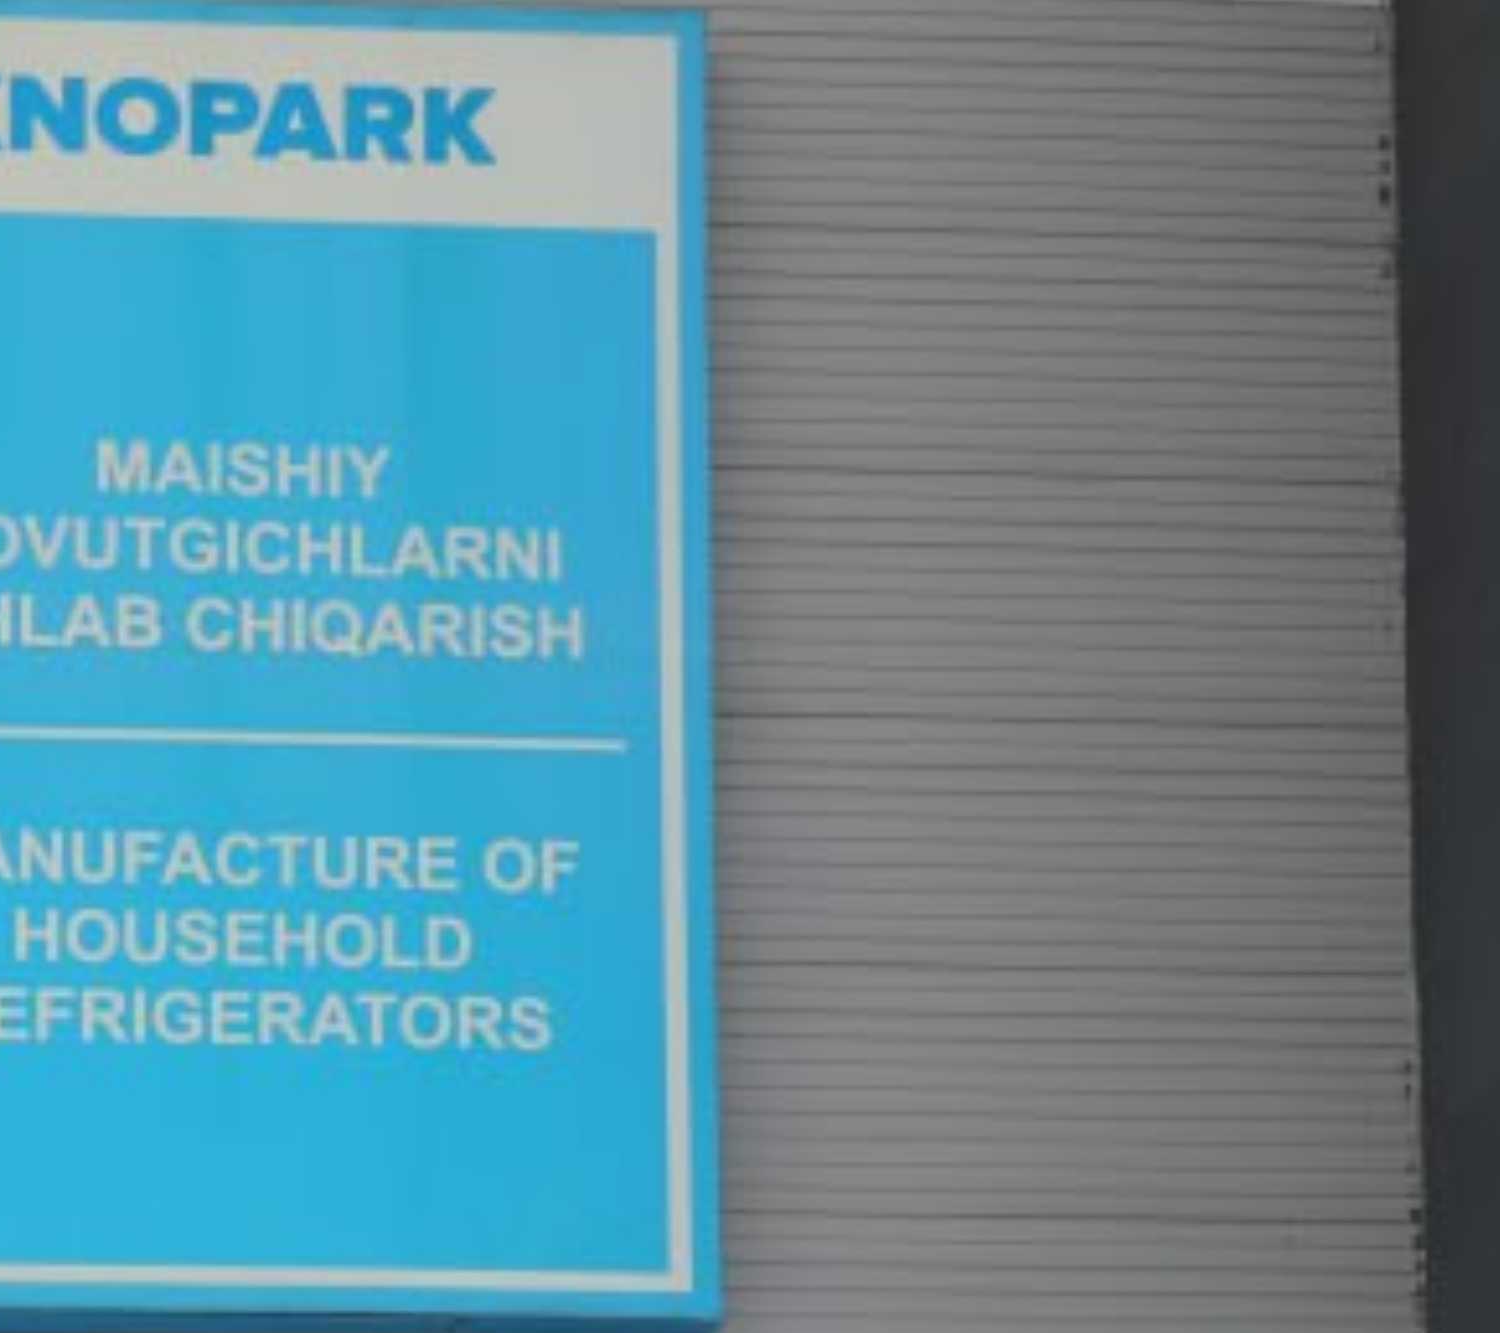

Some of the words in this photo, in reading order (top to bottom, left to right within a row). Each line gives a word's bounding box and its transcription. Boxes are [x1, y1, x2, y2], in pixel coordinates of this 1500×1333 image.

[95, 440, 389, 499] MAISHIY
[185, 597, 584, 662] CHIQARISH
[483, 838, 579, 894] OF
[13, 907, 472, 970] HOUSEHOLD
